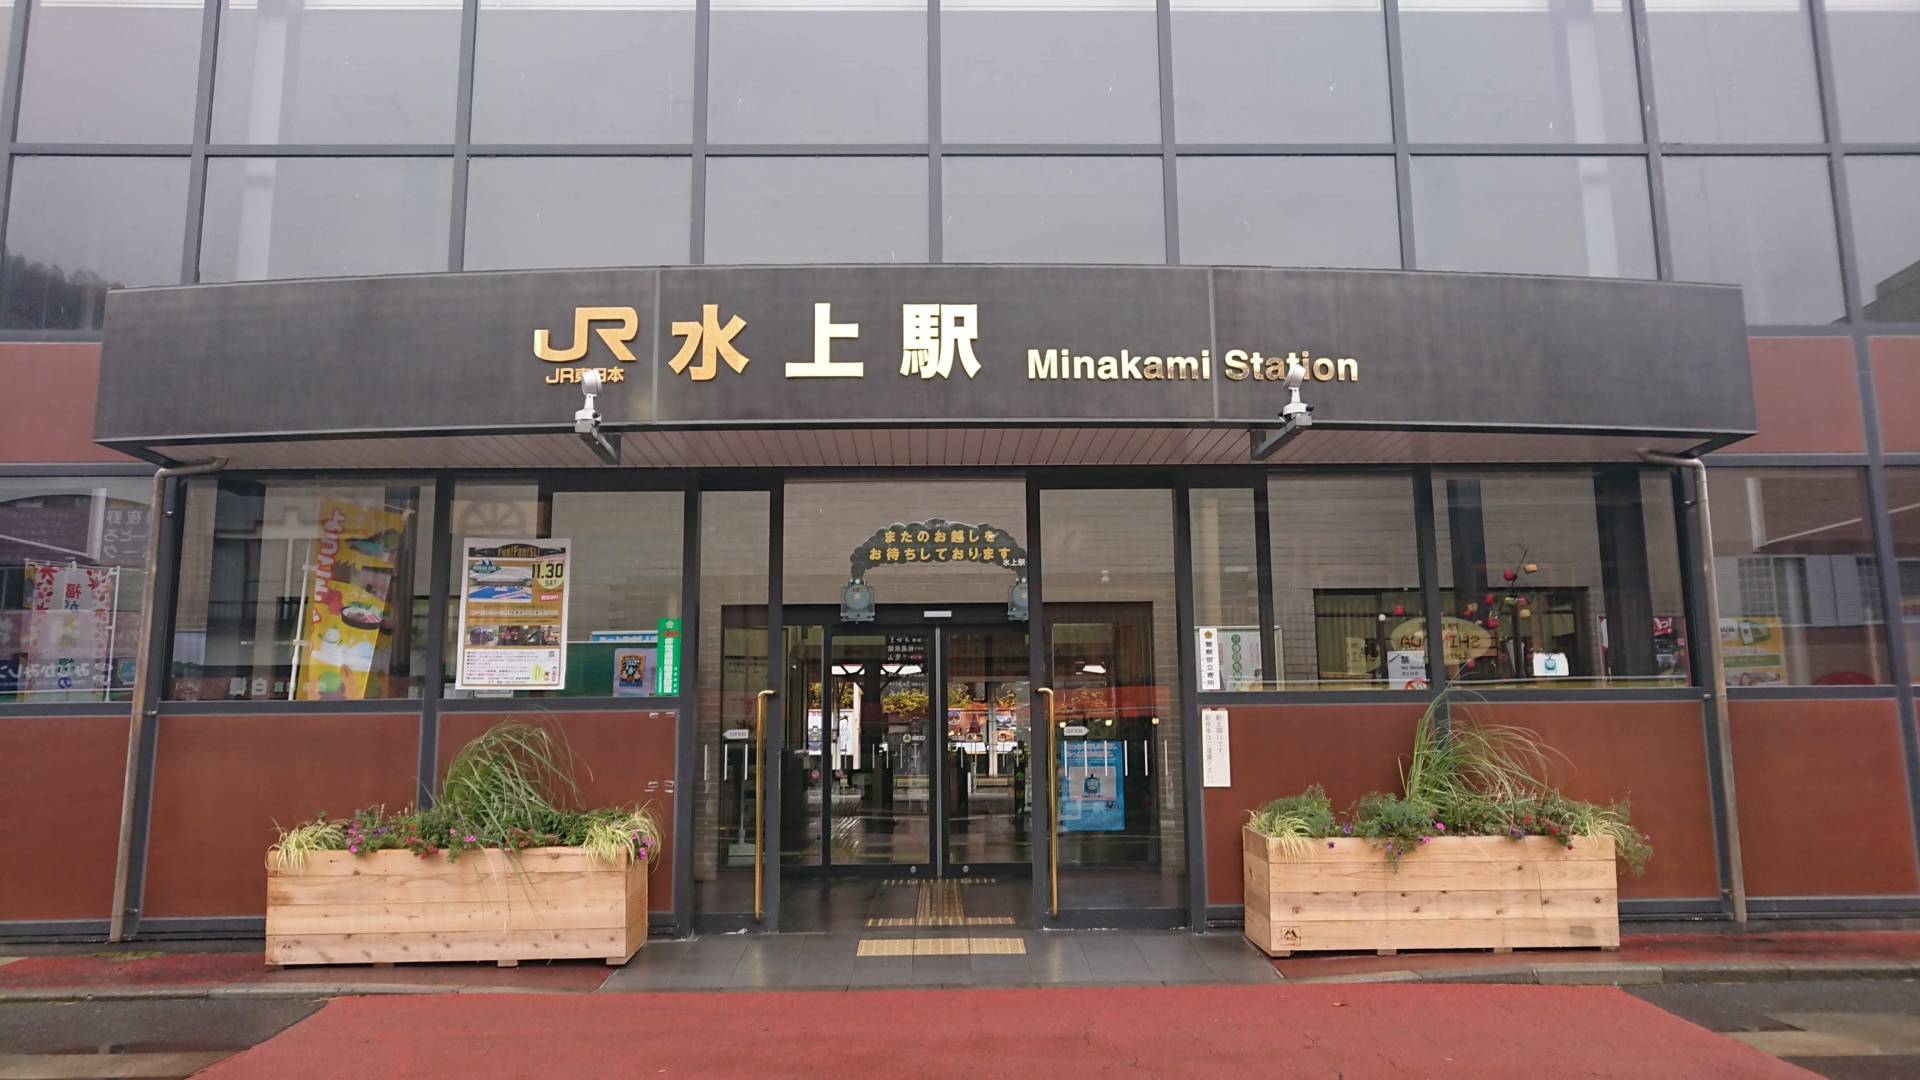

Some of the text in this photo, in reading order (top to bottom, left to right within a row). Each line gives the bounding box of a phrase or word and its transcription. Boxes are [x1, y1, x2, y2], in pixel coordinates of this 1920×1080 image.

[533, 306, 639, 362] JR
[667, 302, 983, 381] 水上駅
[1027, 348, 1211, 381] Minakami
[884, 529, 996, 544] またのお越しを
[869, 547, 1012, 561] お待ちしております
[1002, 557, 1026, 567] 水上駅
[531, 563, 564, 579] 11.30
[544, 579, 557, 587] SAT
[1204, 640, 1215, 687] 警察官立寄所
